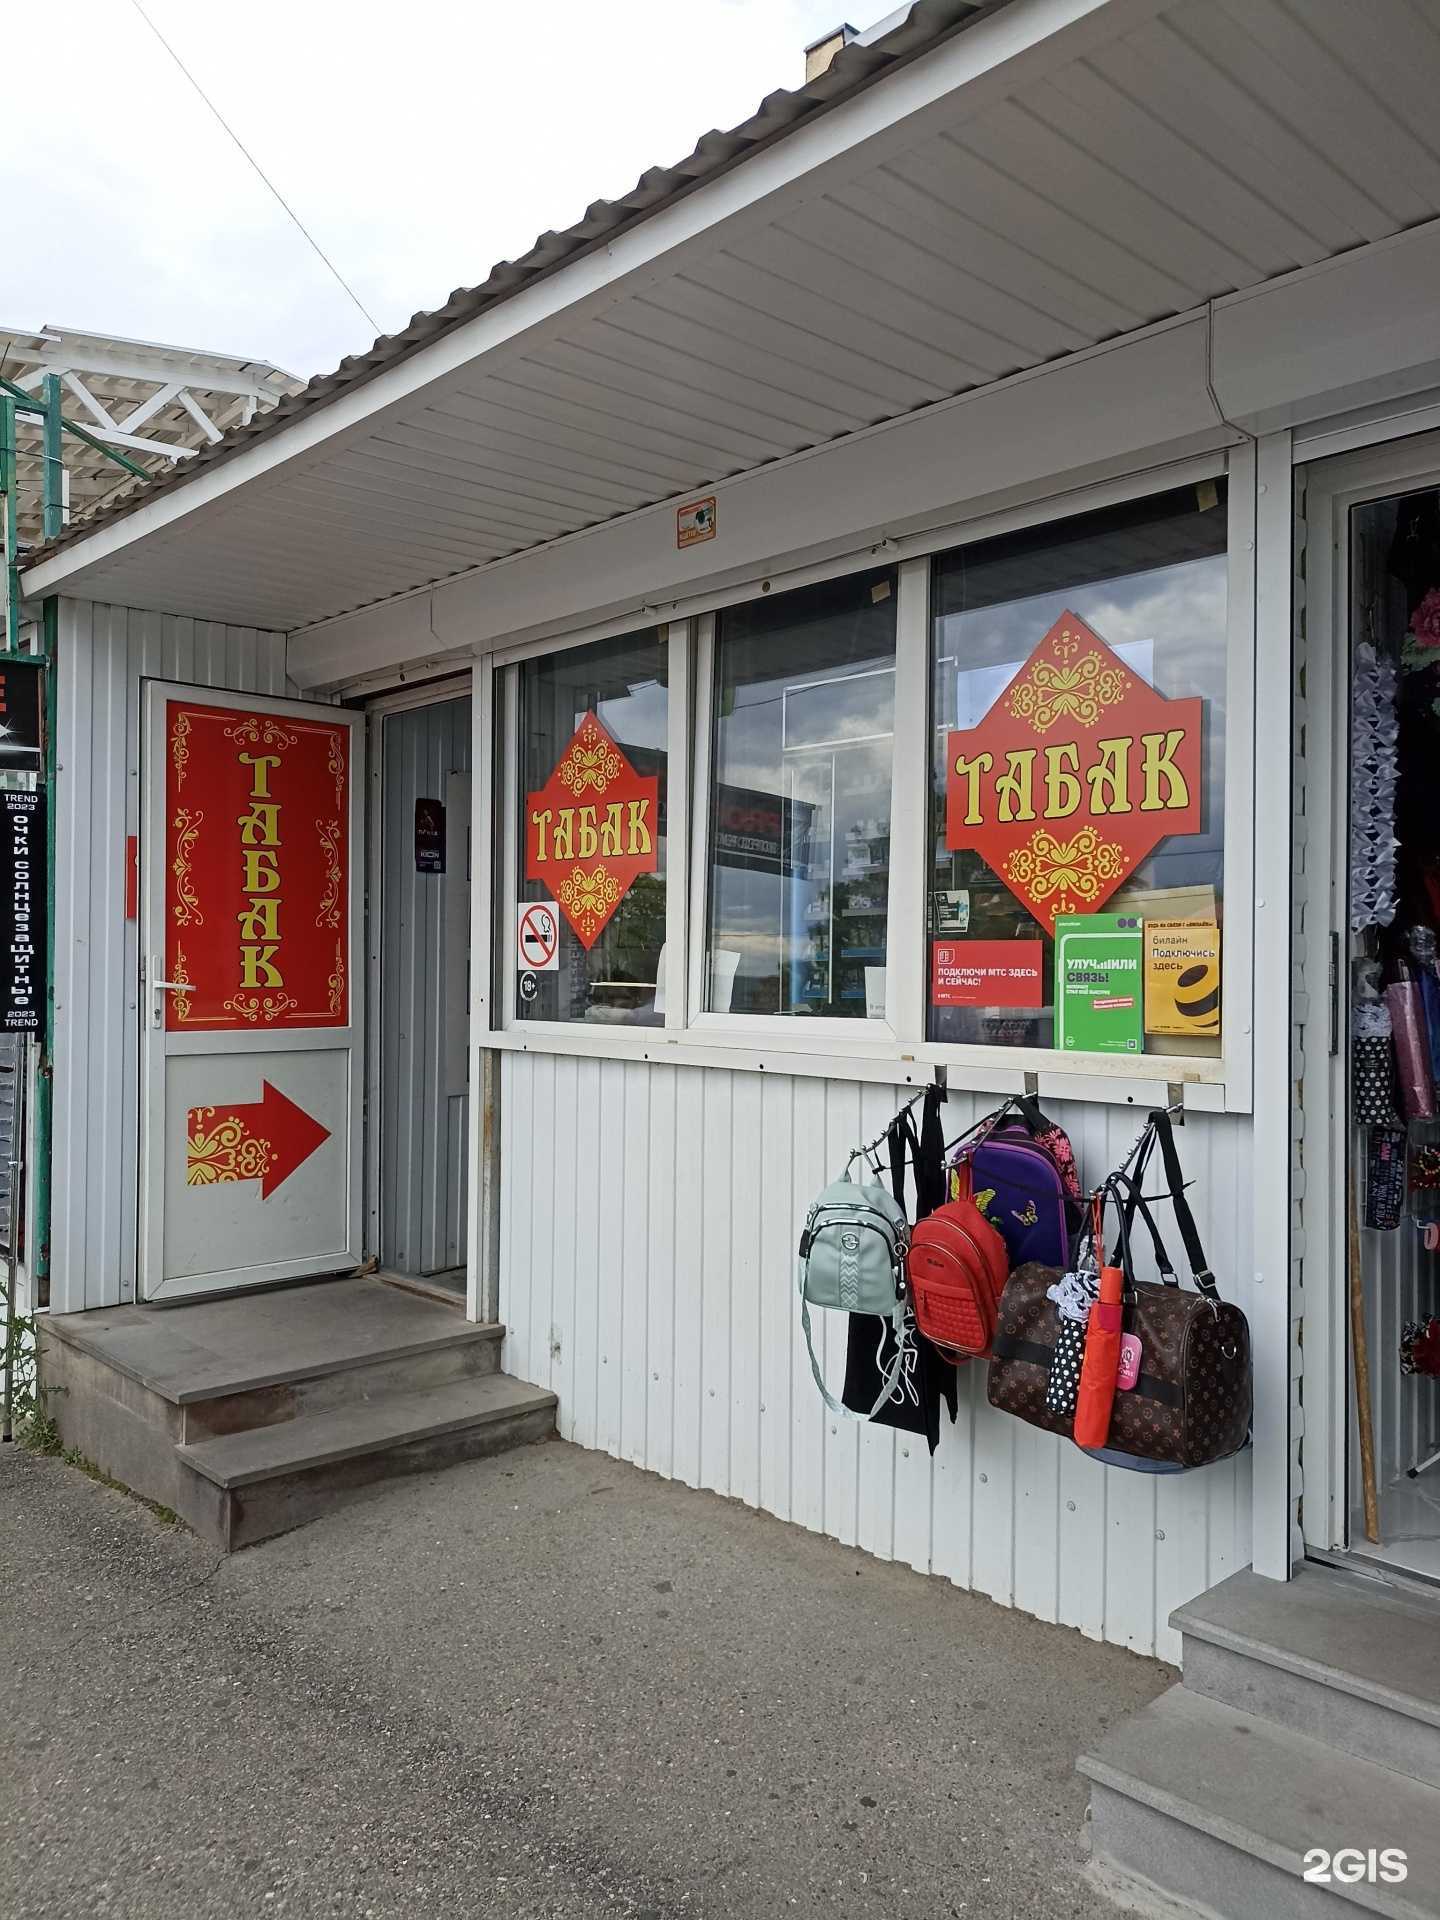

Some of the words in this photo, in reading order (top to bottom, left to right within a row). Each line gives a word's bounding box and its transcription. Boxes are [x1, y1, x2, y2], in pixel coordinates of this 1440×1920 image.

[955, 729, 1190, 825] ТАБАК
[4, 794, 38, 803] TREND
[7, 803, 36, 811] 2023
[531, 798, 653, 862] ТАБАК
[237, 752, 284, 988] ТАБАК
[1152, 935, 1188, 945] билайн
[1152, 948, 1215, 958] Подключись
[1152, 962, 1183, 970] здесь
[937, 968, 987, 977] ПОДКЛЮЧИ
[988, 968, 1007, 976] МТС
[1008, 968, 1038, 978] ЗДЕСЬ
[1066, 972, 1109, 982] СВЯЗЬ!
[523, 980, 536, 991] 18+
[945, 976, 981, 986] СЕЙЧАС!
[4, 1018, 39, 1026] TREND
